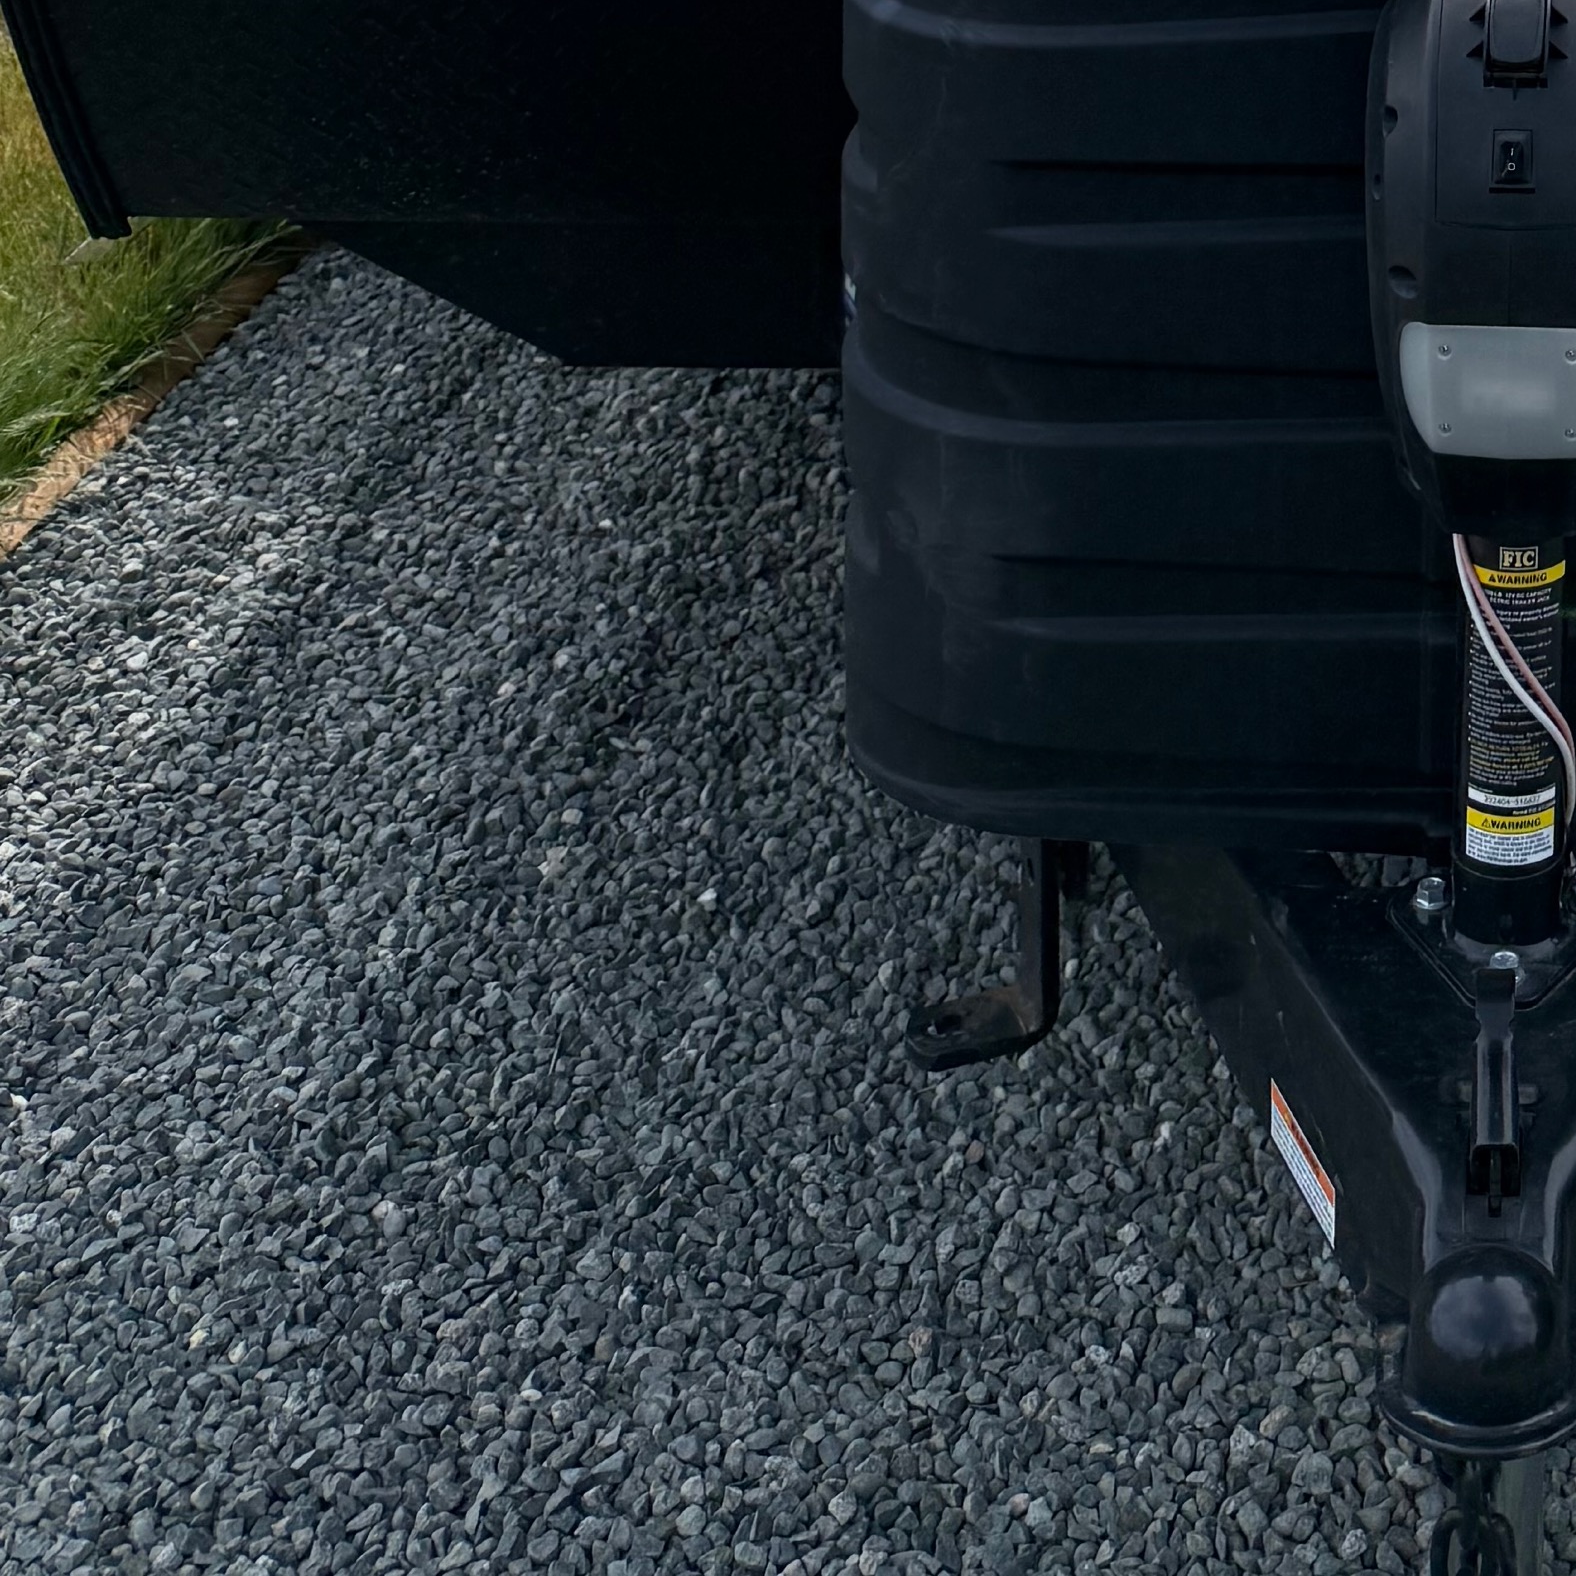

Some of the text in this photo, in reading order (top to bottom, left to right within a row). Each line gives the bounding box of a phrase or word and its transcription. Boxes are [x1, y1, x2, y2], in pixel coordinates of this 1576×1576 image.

[1502, 550, 1535, 567] FIC
[1497, 573, 1547, 584] WARNING
[1491, 817, 1542, 830] WARNING
